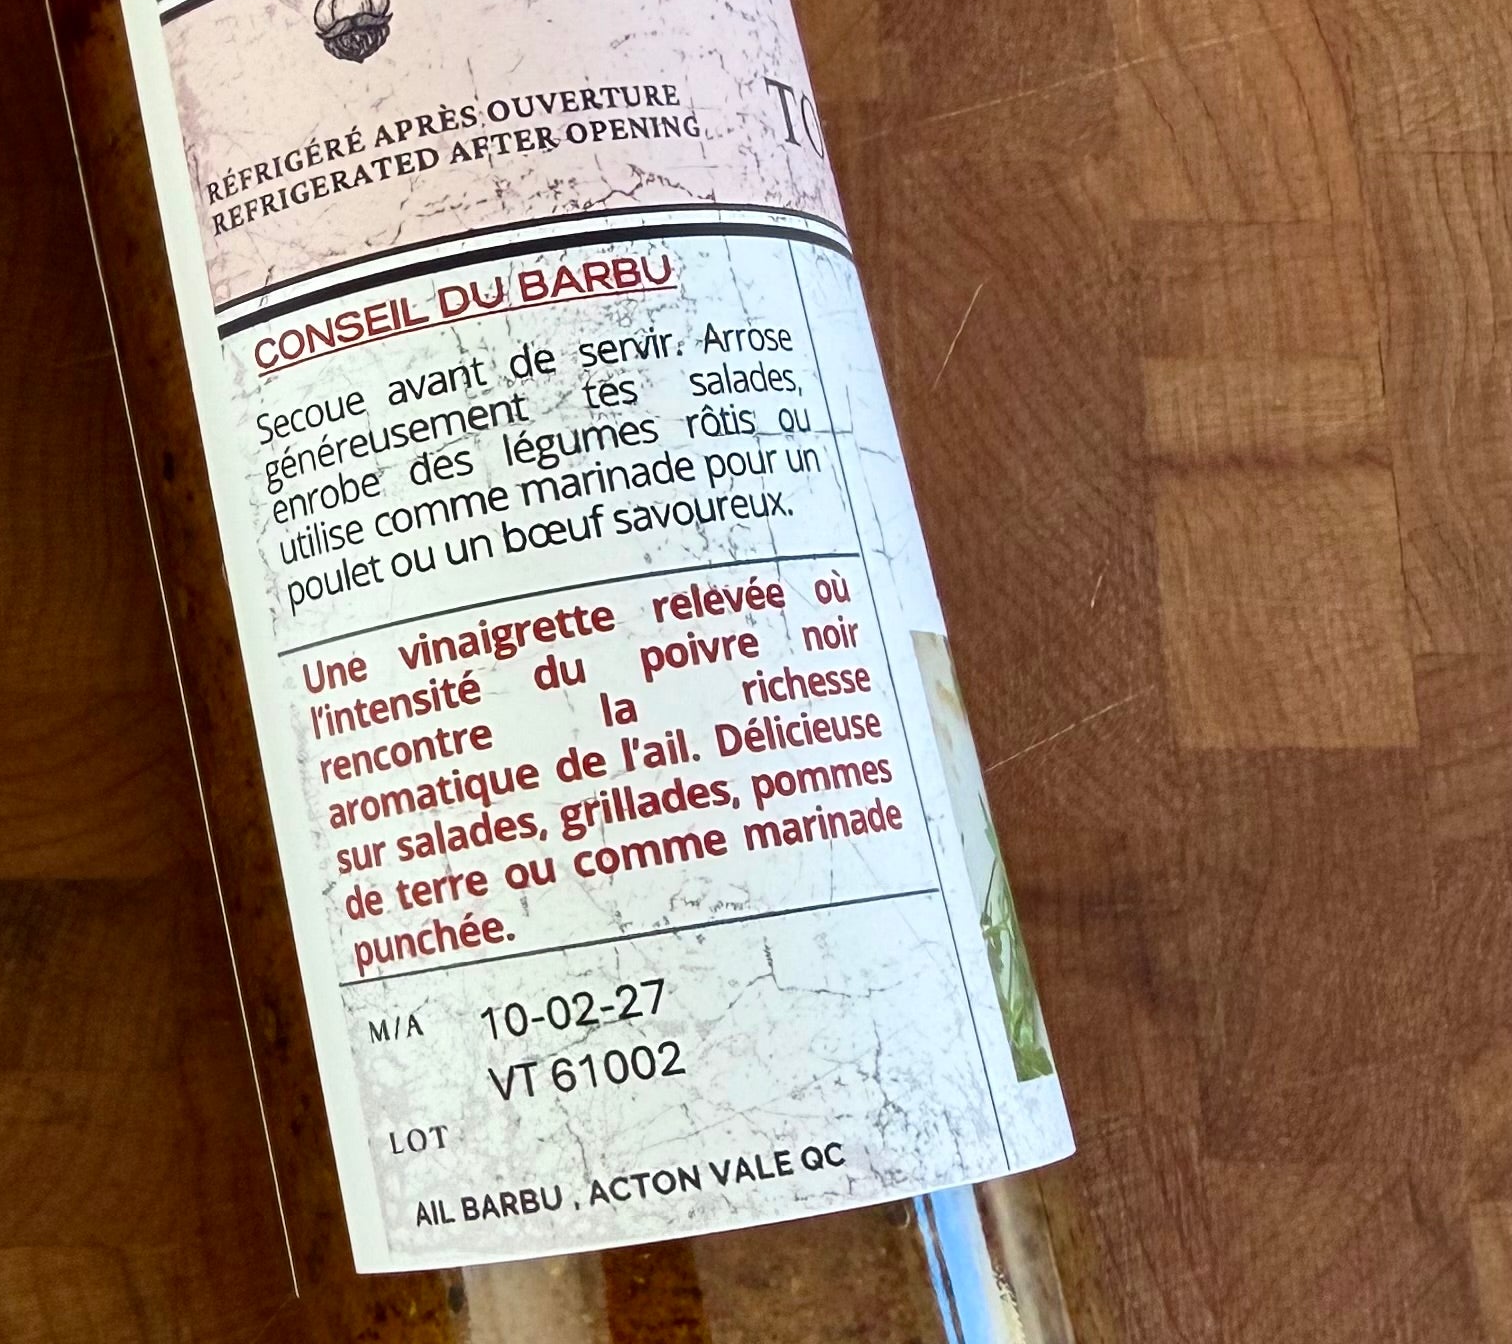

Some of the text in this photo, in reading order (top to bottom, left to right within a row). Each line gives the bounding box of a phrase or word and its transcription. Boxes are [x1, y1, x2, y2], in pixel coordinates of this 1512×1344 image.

[206, 84, 681, 206] RÉFRIGÉRÉ APRÈS OUVERTURE
[211, 116, 702, 237] REFRIGERATED AFTER OPENING
[255, 254, 673, 369] CONSEIL DU BARBU
[256, 389, 366, 446] Secoue
[388, 360, 487, 406] avant
[510, 344, 555, 379] de
[704, 323, 793, 354] Arrose
[265, 367, 803, 495] généreusement tes salades,
[272, 407, 811, 524] enrobe des légumes rôtis ou
[280, 449, 822, 565] utilise comme marinade pour un
[286, 490, 793, 617] poulet ou un bœuf savoureux.
[303, 571, 851, 693] Une vinaigrette relevée où
[311, 618, 859, 740] l'intensité du poivre noir
[320, 667, 872, 784] rencontre la richesse
[329, 713, 882, 830] aromatique de l'ail. Délicieuse
[338, 758, 892, 874] sur salades, grillades, pommes
[346, 798, 903, 921] de terre ou comme marinade
[355, 912, 516, 977] punchée.
[368, 978, 666, 1045] M/A 10-02-27
[489, 1040, 686, 1102] VT 61002
[389, 1125, 448, 1155] LOT
[416, 1200, 455, 1228] AIL
[462, 1185, 563, 1222] BARBU
[589, 1166, 702, 1207] ACTON
[707, 1151, 794, 1186] VALE
[802, 1142, 846, 1170] QC
